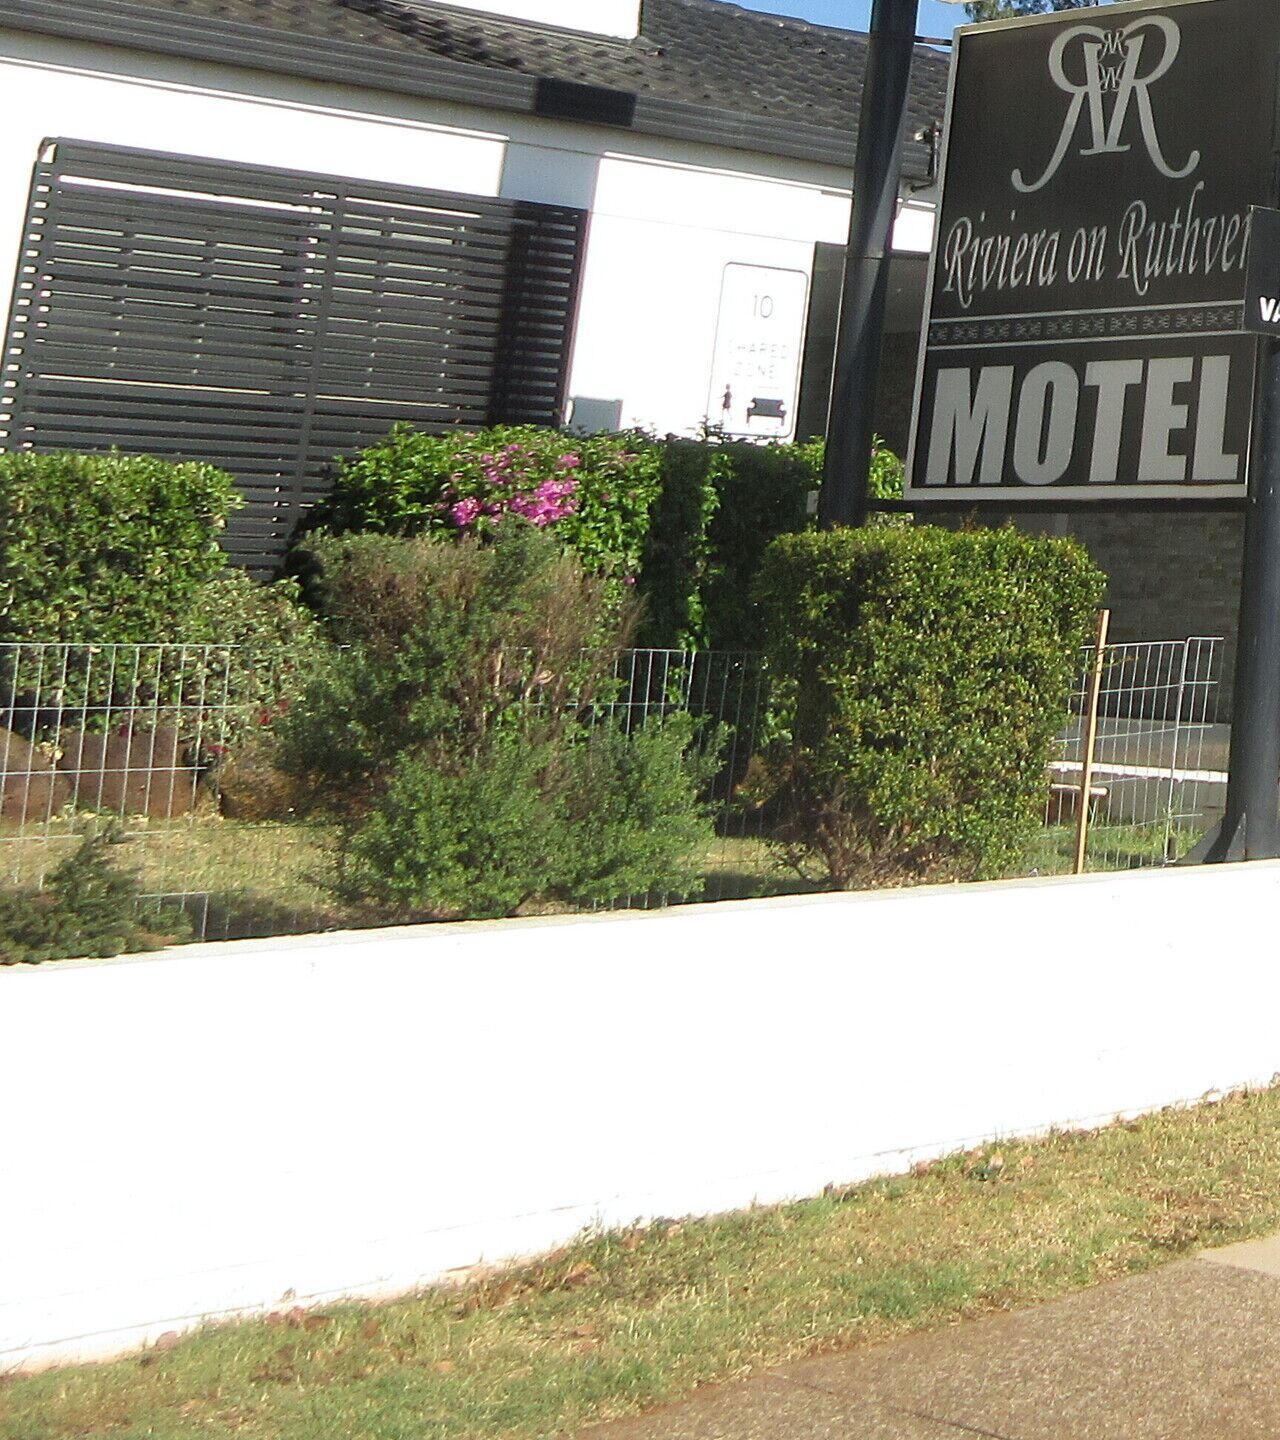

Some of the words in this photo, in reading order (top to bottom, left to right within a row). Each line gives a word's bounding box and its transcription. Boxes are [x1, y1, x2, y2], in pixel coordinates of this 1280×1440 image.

[753, 294, 774, 318] 10
[942, 210, 1060, 308] Riviera
[1068, 225, 1108, 283] on
[924, 355, 1240, 486] MOTEL
